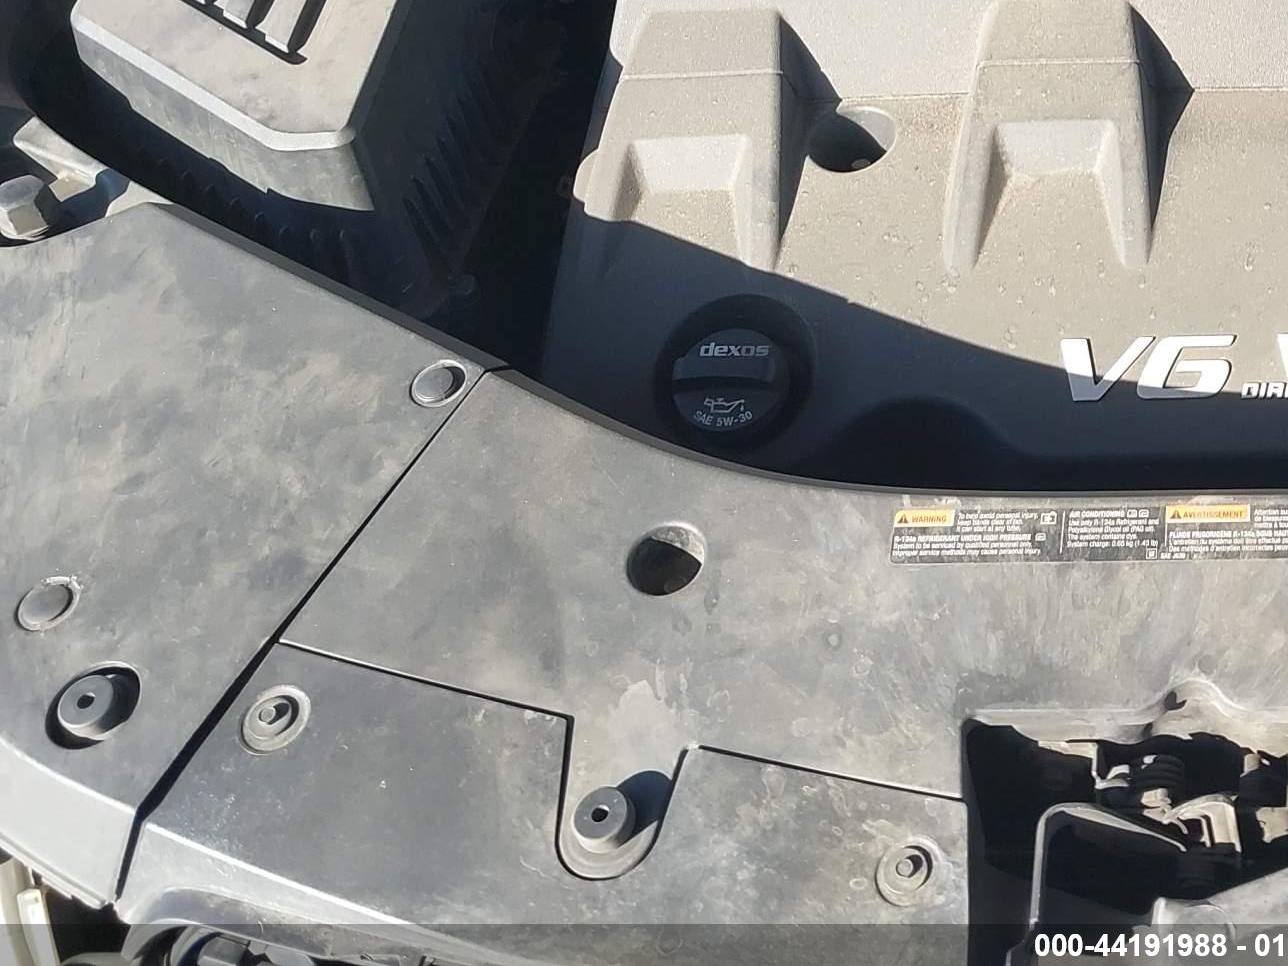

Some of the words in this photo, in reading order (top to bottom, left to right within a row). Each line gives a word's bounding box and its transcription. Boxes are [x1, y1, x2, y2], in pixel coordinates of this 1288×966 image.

[700, 342, 772, 357] dexos
[1060, 335, 1237, 402] V6
[693, 410, 713, 426] SAE
[716, 410, 753, 427] 5W-30
[912, 514, 947, 523] WARNING
